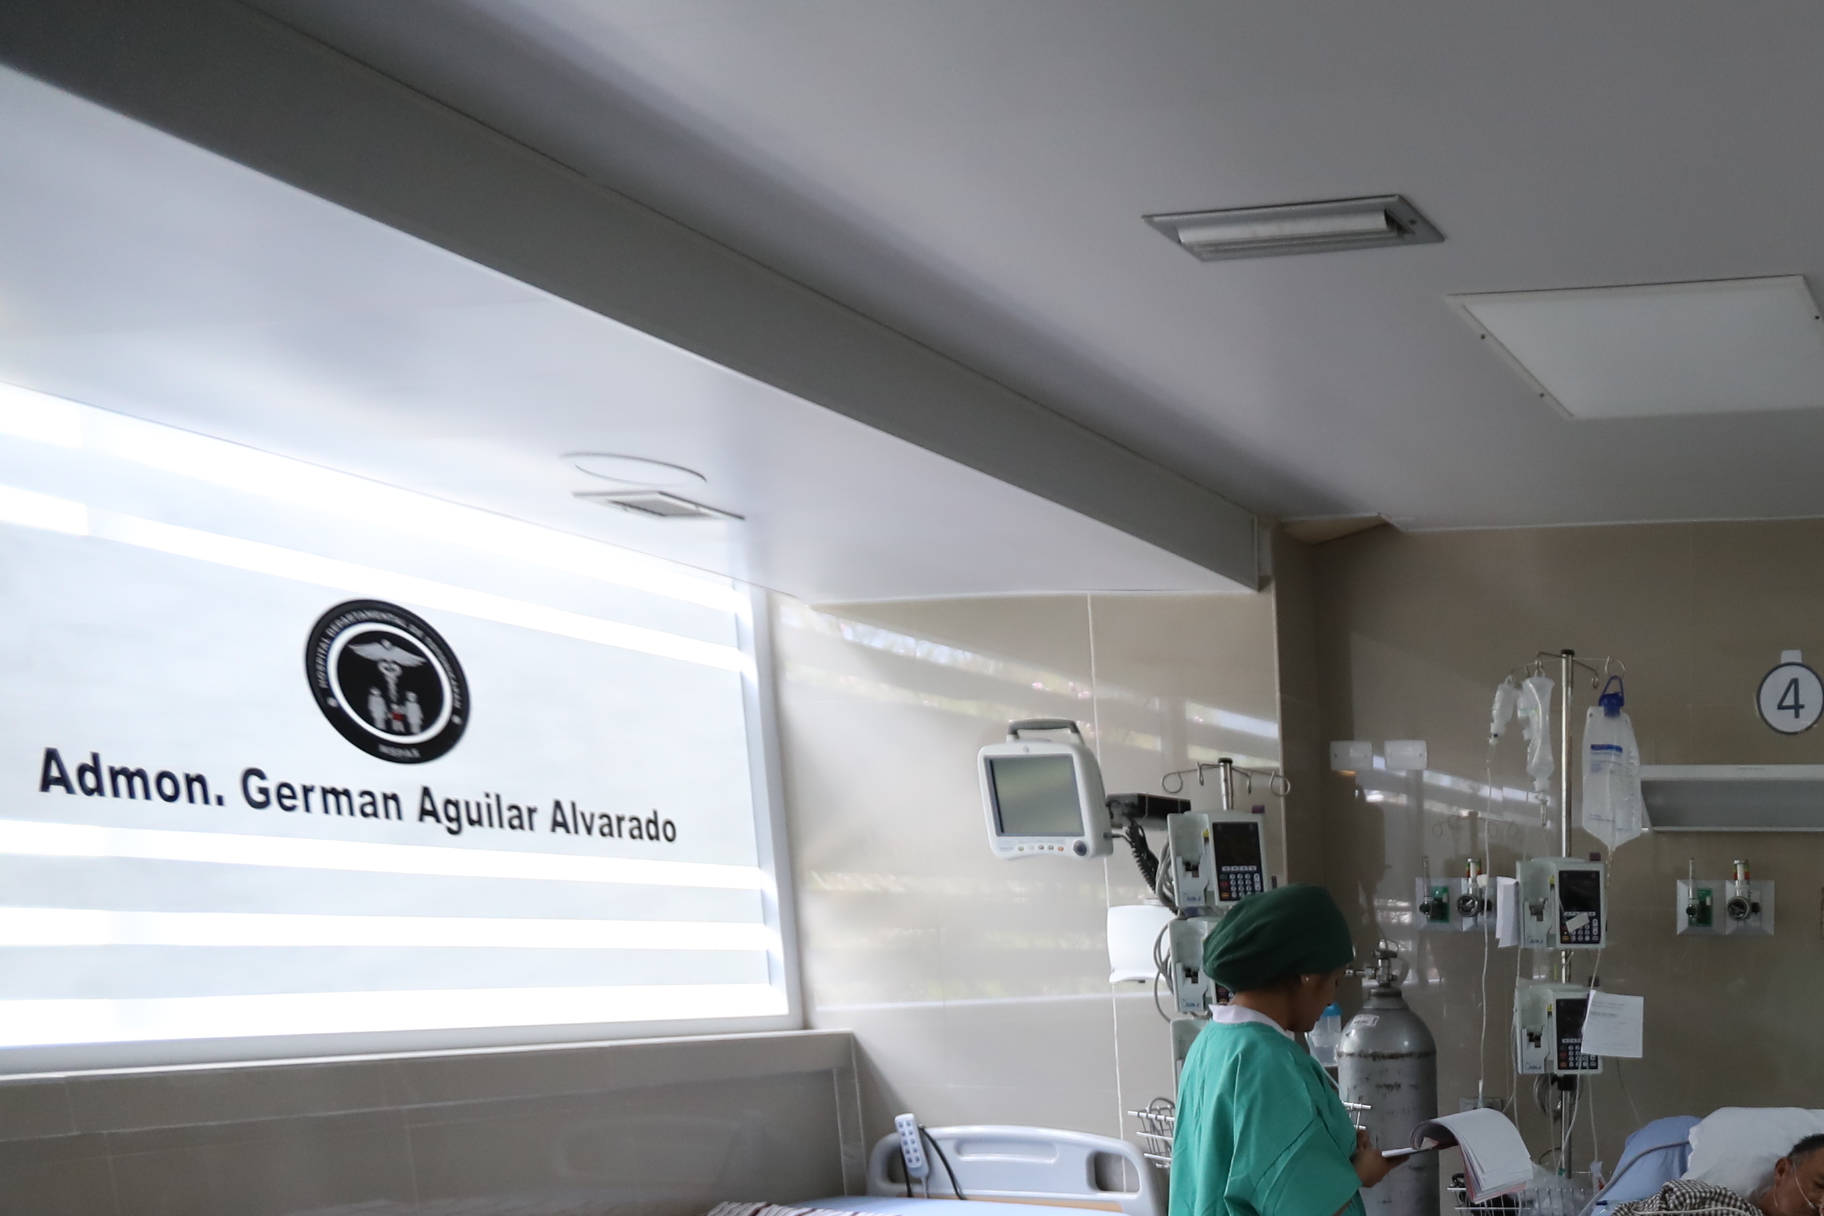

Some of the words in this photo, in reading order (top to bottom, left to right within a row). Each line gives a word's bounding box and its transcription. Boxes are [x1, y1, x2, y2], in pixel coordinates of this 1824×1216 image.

[1777, 678, 1805, 718] 4
[39, 746, 225, 807] Admon.
[241, 766, 403, 821] German
[417, 784, 538, 836] Aguilar
[550, 798, 677, 843] Alvarado
